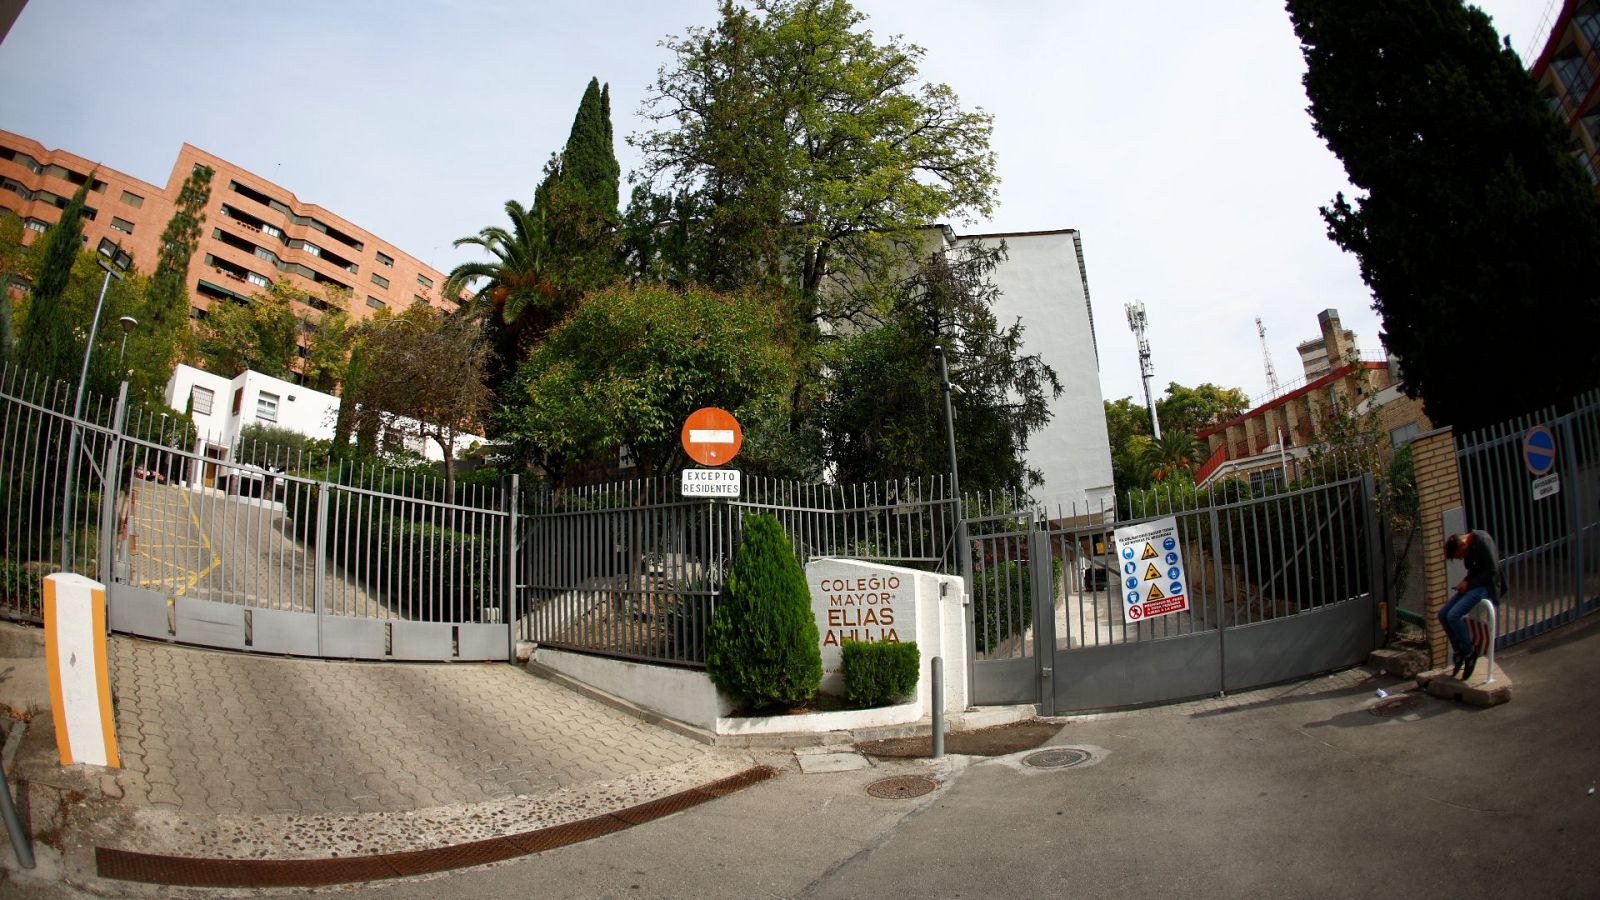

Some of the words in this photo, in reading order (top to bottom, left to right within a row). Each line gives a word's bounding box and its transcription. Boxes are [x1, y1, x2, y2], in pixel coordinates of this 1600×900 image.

[687, 471, 735, 481] EXCEPTO
[683, 483, 739, 494] RESIDENTES
[820, 576, 900, 592] COLEGIO
[830, 592, 891, 606] MAYOR
[828, 608, 895, 626] ELIAS
